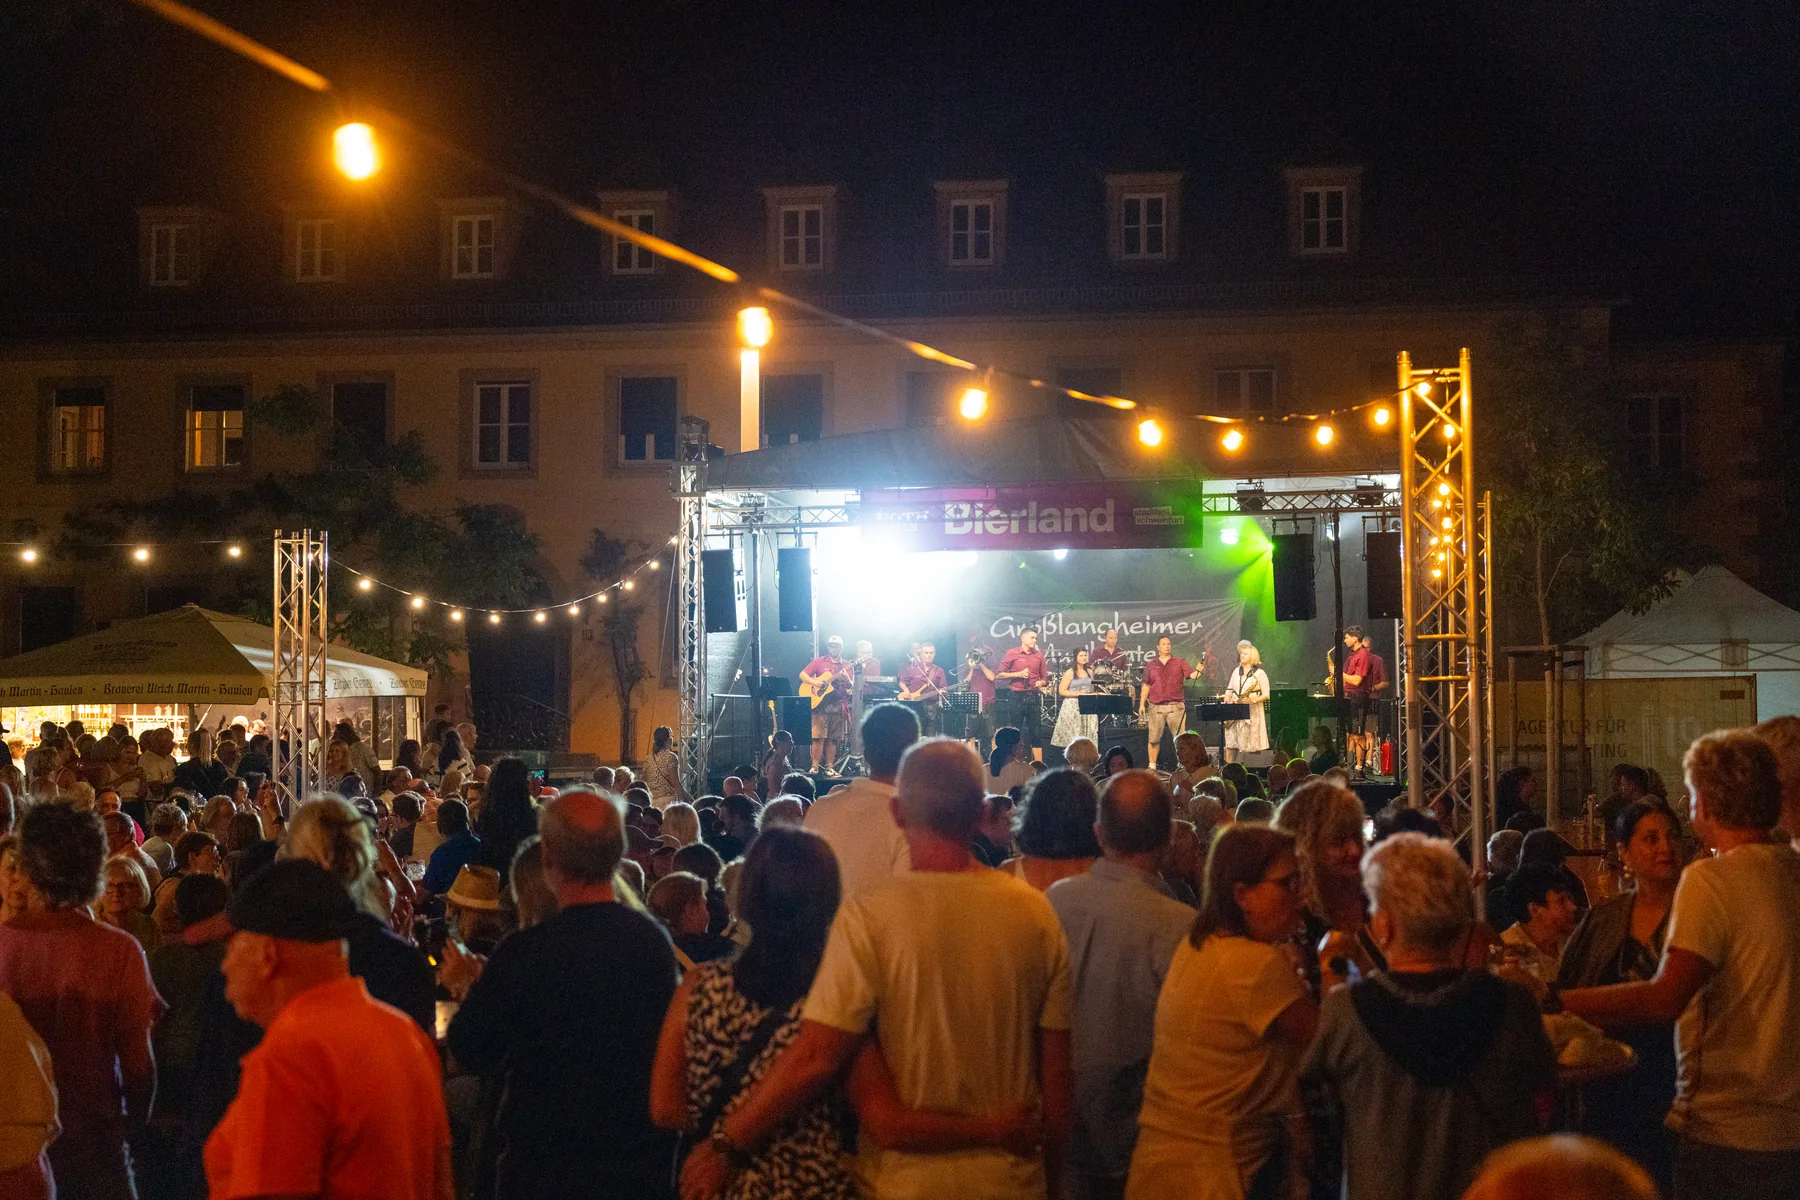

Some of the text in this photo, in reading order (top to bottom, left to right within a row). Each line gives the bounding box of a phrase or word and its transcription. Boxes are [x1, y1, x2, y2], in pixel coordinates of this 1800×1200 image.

[944, 499, 1115, 535] Bierland
[9, 685, 42, 697] Martin
[103, 683, 144, 695] Brauerei
[147, 682, 174, 694] Ulrich
[177, 682, 210, 694] Martin
[1518, 719, 1591, 734] AGETUR
